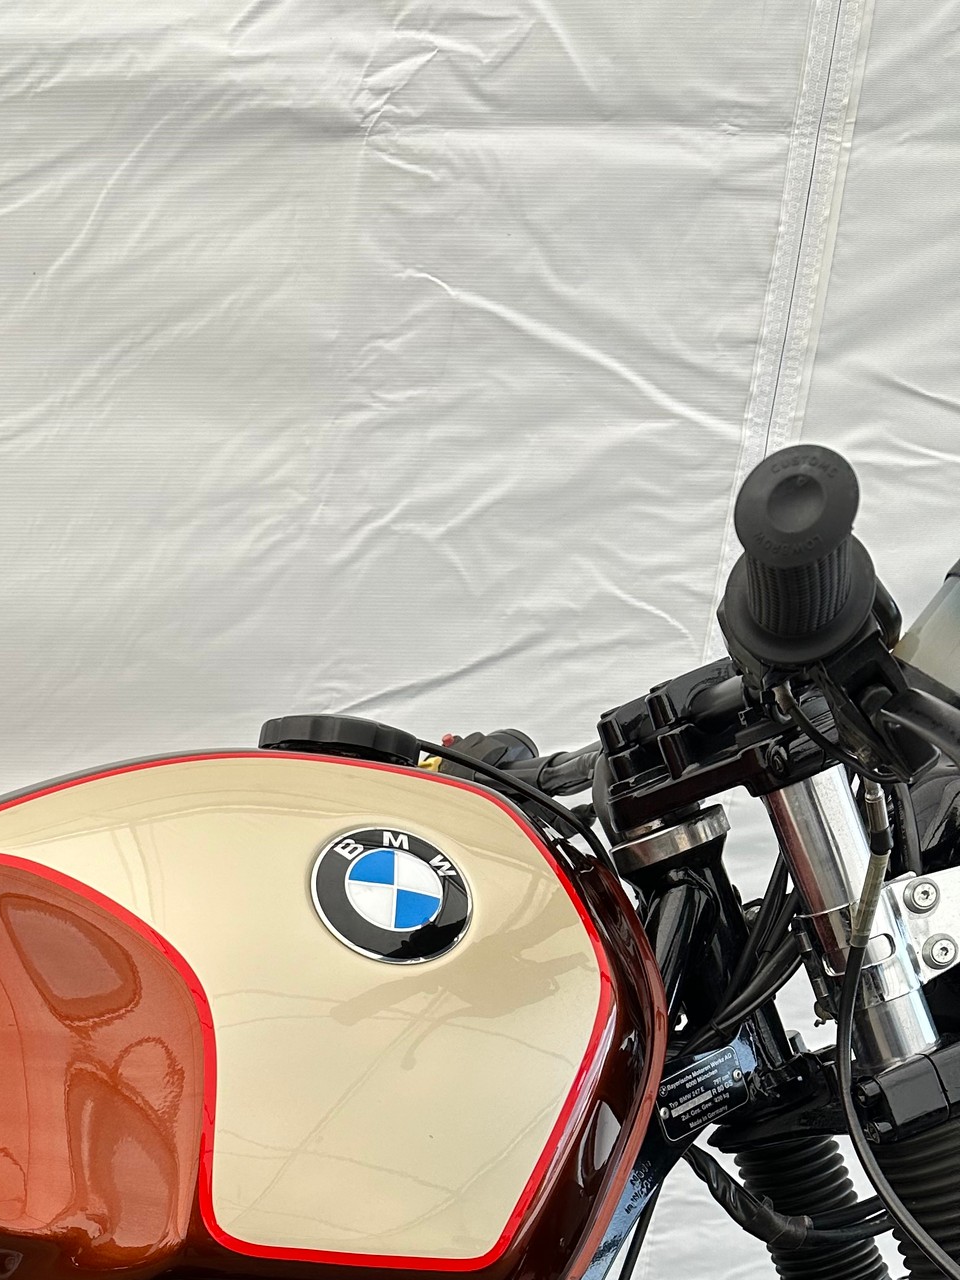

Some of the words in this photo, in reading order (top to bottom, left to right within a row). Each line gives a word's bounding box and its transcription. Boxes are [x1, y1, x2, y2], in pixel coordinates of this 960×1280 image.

[333, 831, 457, 877] BMW
[667, 1075, 692, 1090] Bayerische
[692, 1066, 710, 1076] Motoren
[710, 1058, 724, 1067] Werke
[697, 1069, 718, 1082] München
[689, 1120, 702, 1128] Made
[707, 1105, 728, 1118] Germany
